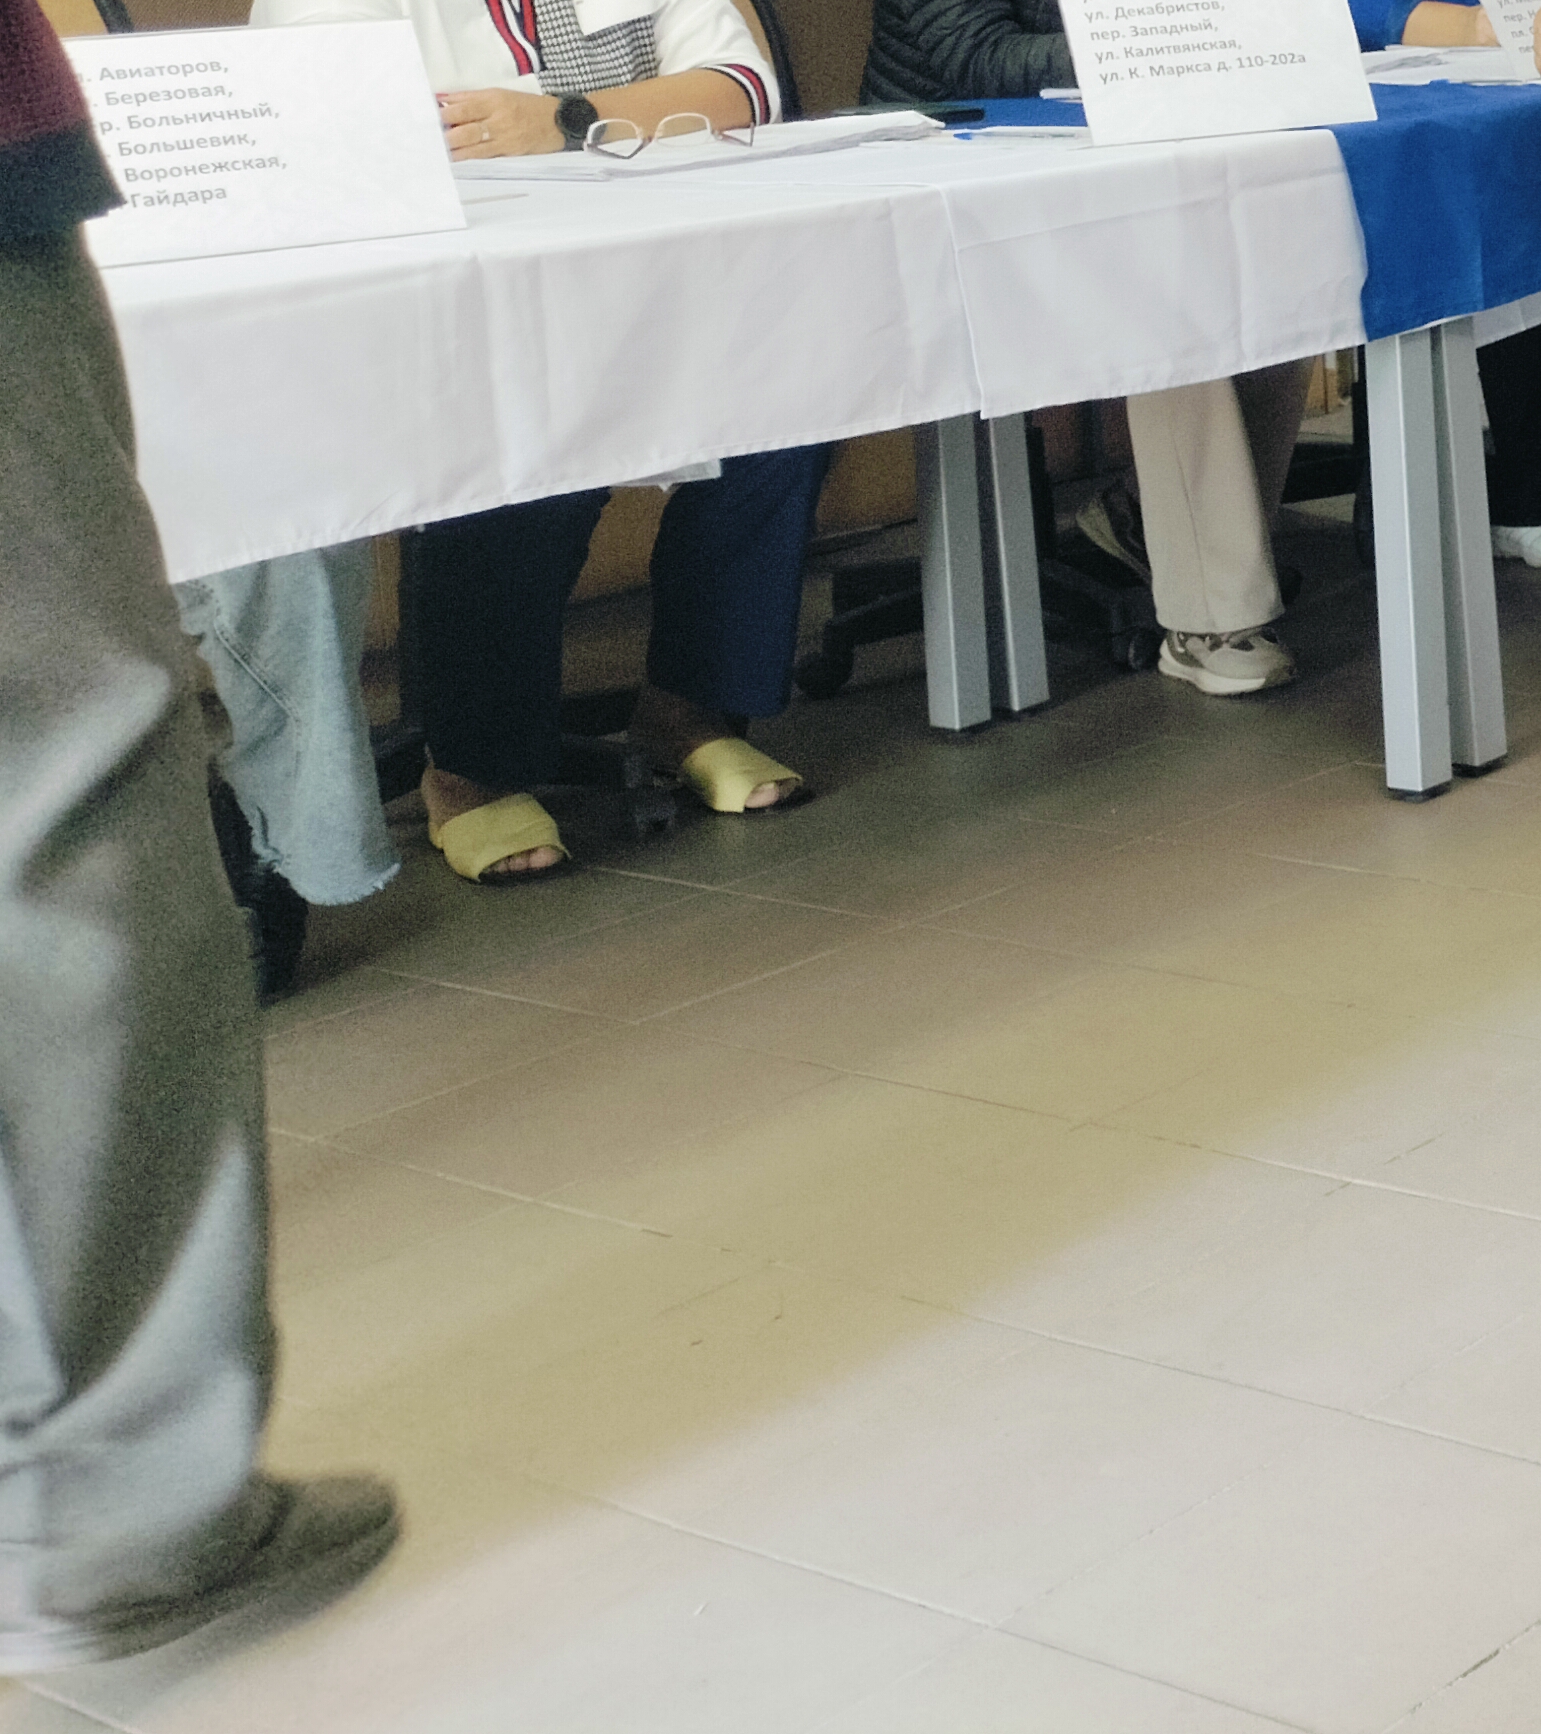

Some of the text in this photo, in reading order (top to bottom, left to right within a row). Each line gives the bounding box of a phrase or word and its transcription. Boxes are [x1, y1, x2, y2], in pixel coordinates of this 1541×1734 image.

[1084, 0, 1226, 23] ул. Декабристов,
[1090, 18, 1219, 42] пер. Западный,
[1094, 38, 1242, 64] ул. Калитвянская,
[98, 60, 229, 81] Авиаторов,
[1099, 52, 1307, 85] ул. К. Маркса д. 110-202а
[104, 84, 233, 107] Березовая,
[127, 102, 280, 130] Больничный,
[117, 133, 256, 157] Большевик,
[124, 156, 287, 183] Воронежская,
[129, 187, 227, 209] Гайдара
